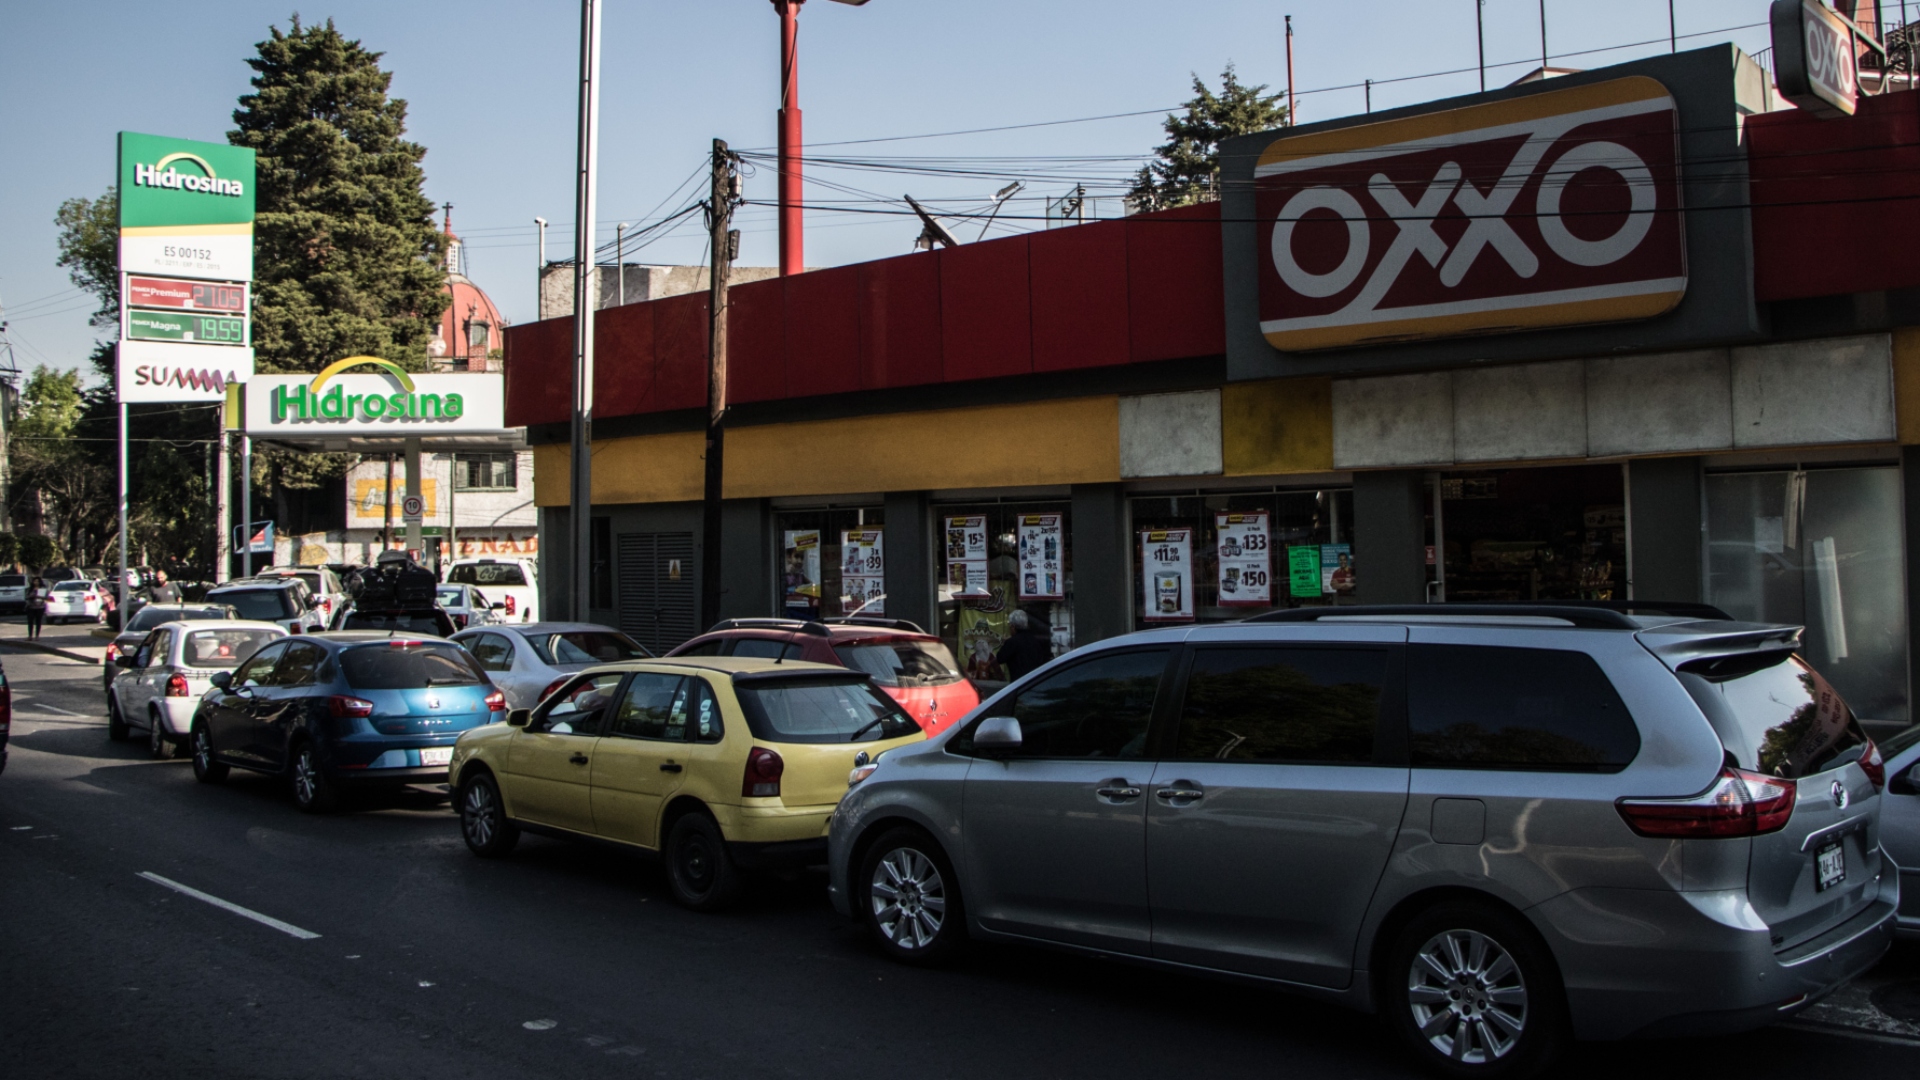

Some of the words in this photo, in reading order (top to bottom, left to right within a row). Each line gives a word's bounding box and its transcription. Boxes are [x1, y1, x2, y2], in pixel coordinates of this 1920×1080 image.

[1807, 20, 1853, 94] OXXO
[135, 162, 243, 197] Hidrosina
[1271, 134, 1657, 306] OXXO
[164, 246, 176, 257] ES
[178, 247, 211, 260] 00152
[151, 287, 190, 298] Premium
[192, 285, 241, 309] 21.05
[151, 321, 181, 332] Magna
[201, 318, 241, 341] 19.59
[277, 384, 464, 419] Hidrosina
[408, 501, 418, 510] 10
[1242, 534, 1267, 550] $133
[1241, 571, 1266, 586] $150
